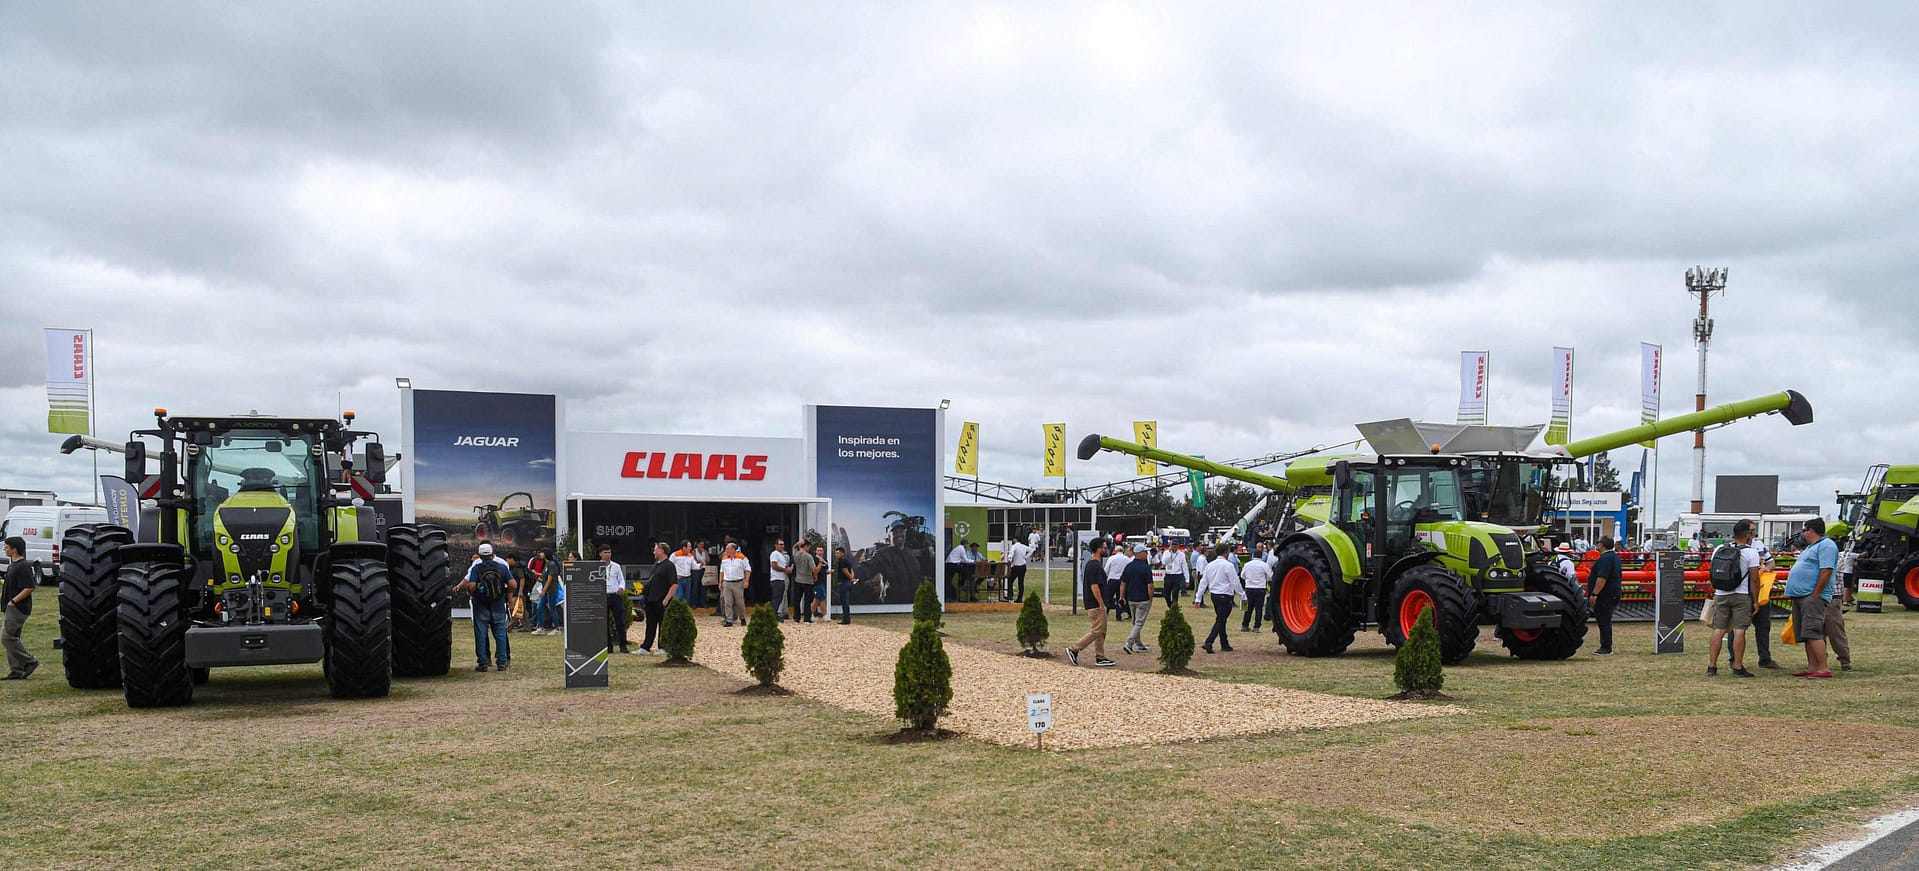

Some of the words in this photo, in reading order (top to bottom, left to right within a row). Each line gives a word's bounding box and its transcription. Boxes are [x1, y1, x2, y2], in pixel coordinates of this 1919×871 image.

[453, 436, 520, 447] JAGUAR
[838, 435, 886, 446] Inspirada
[838, 448, 854, 457] los
[856, 449, 900, 460] mejores.
[620, 451, 769, 481] CLAAS
[596, 525, 635, 536] SHOP
